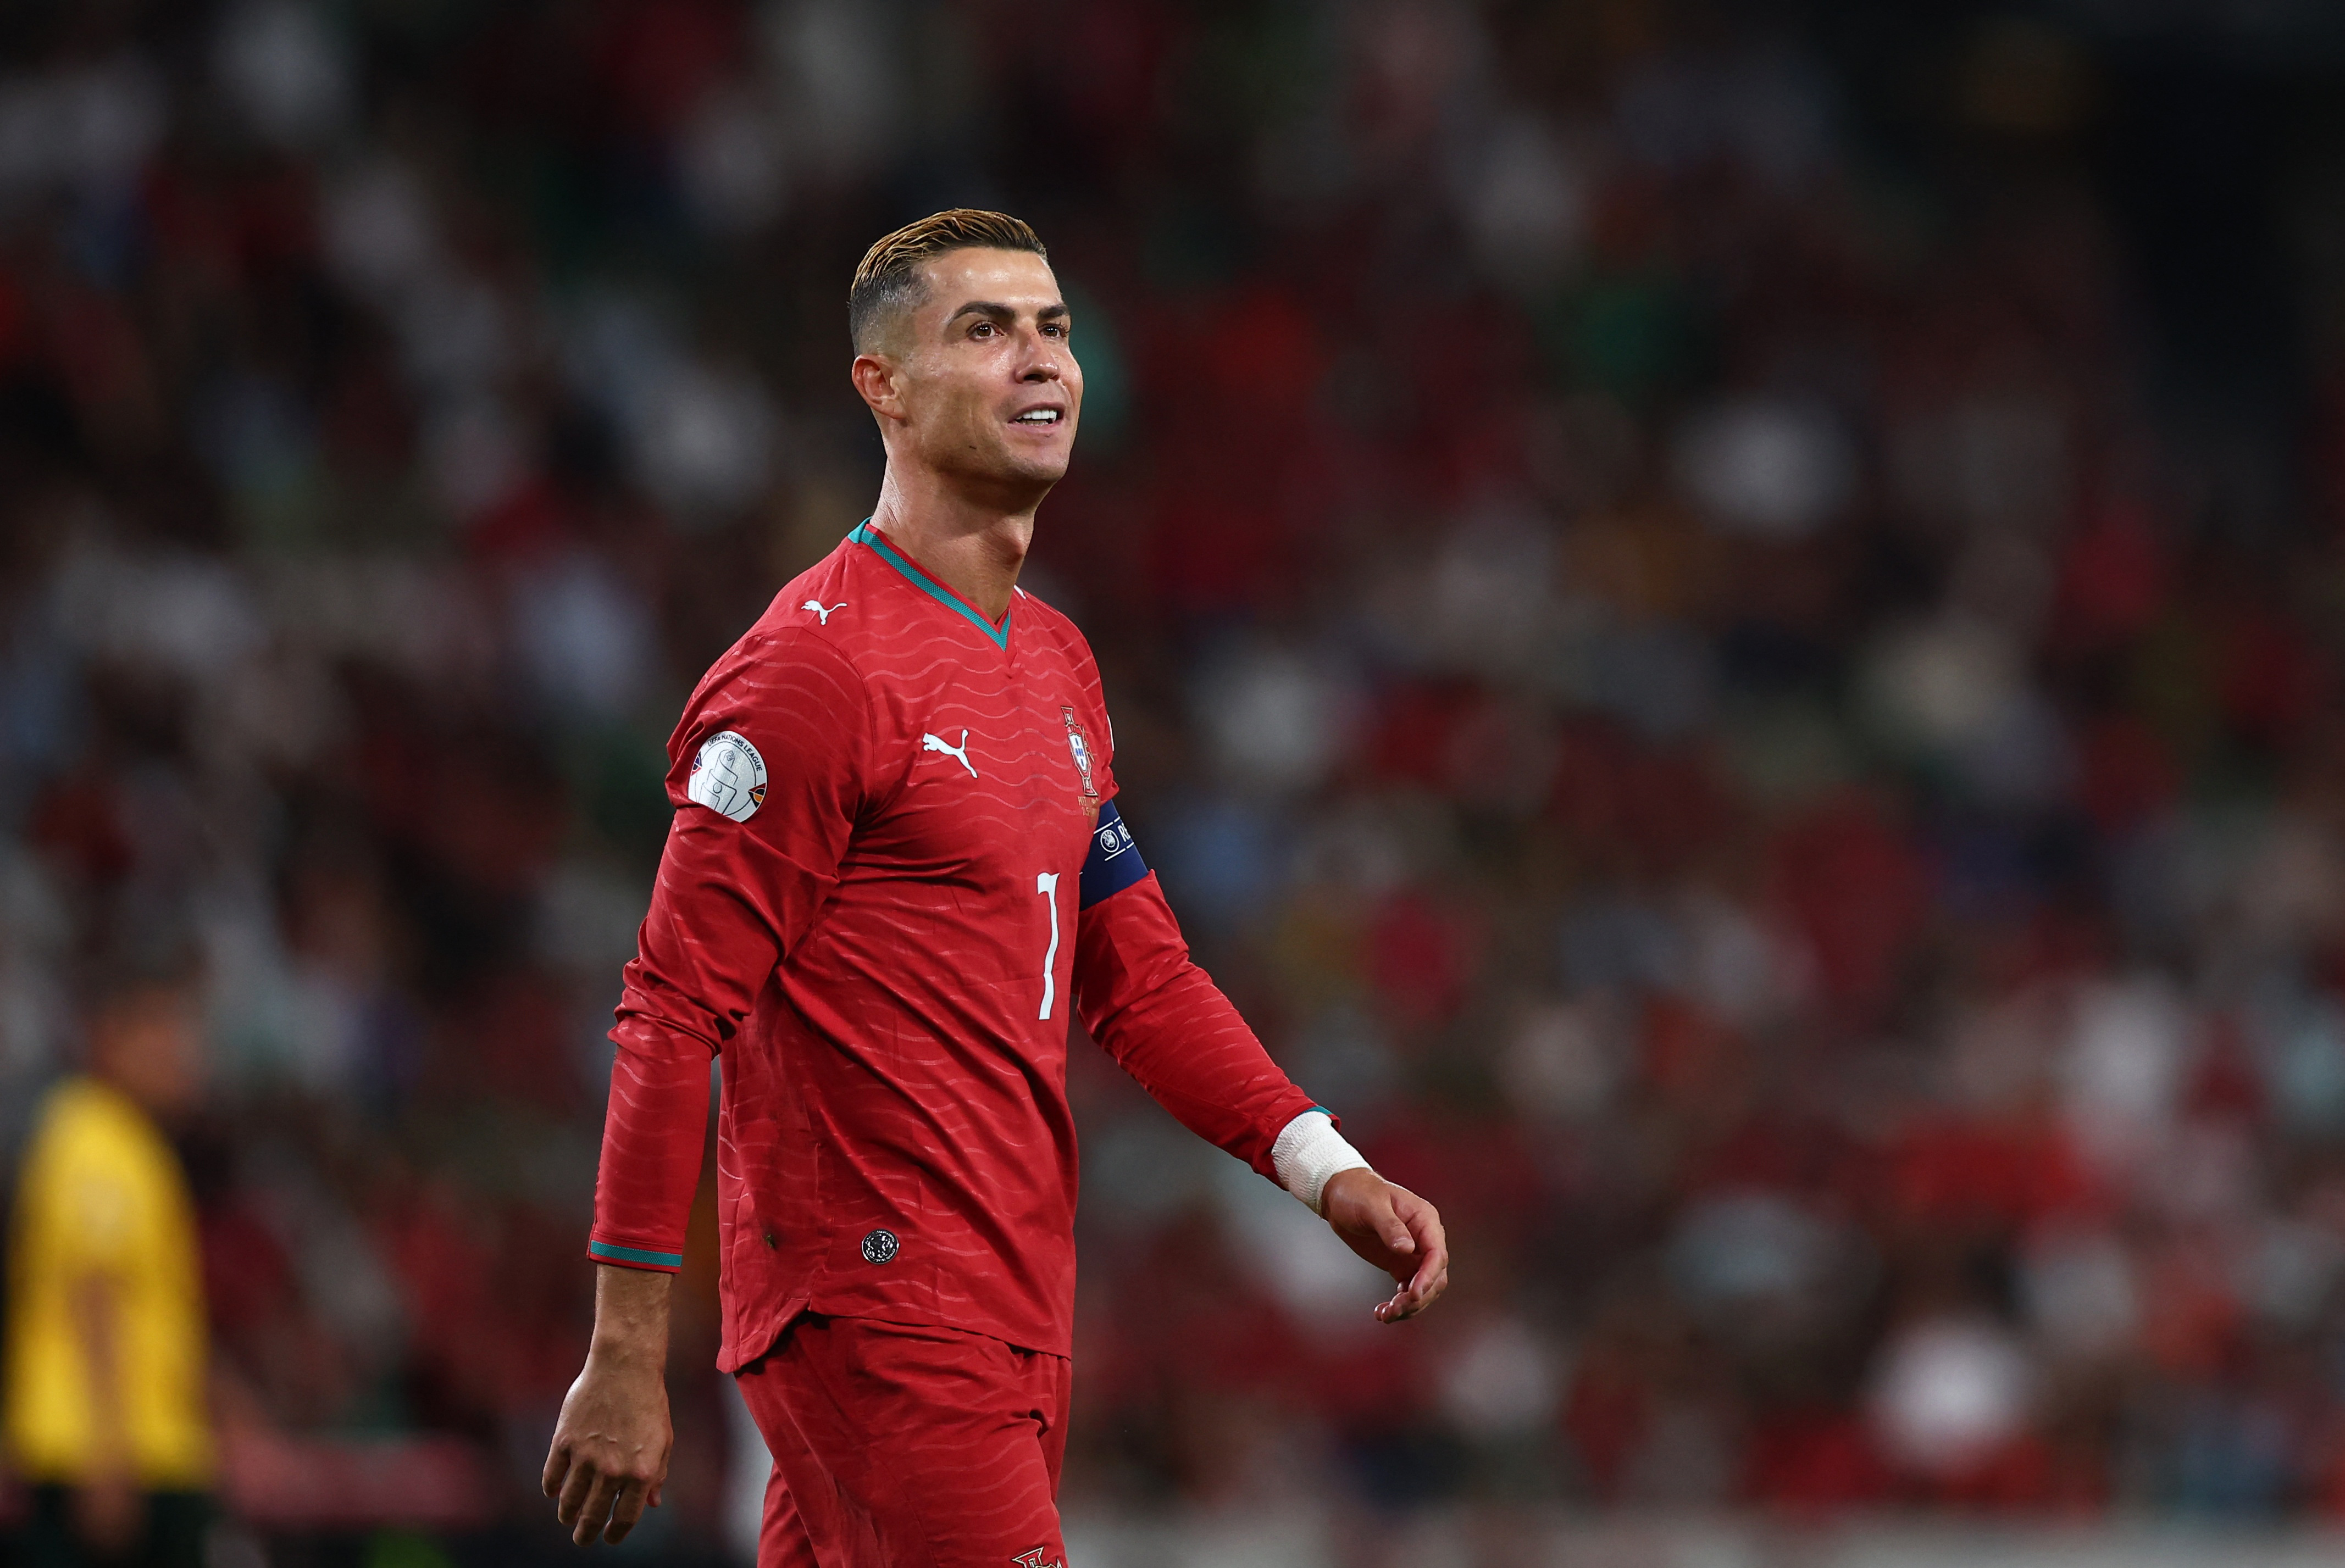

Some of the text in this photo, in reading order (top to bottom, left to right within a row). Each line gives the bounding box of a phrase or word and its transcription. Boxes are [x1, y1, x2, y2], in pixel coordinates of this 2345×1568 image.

[707, 734, 763, 772] UEFA NATIONS LEAGUE
[1036, 871, 1061, 1020] 7
